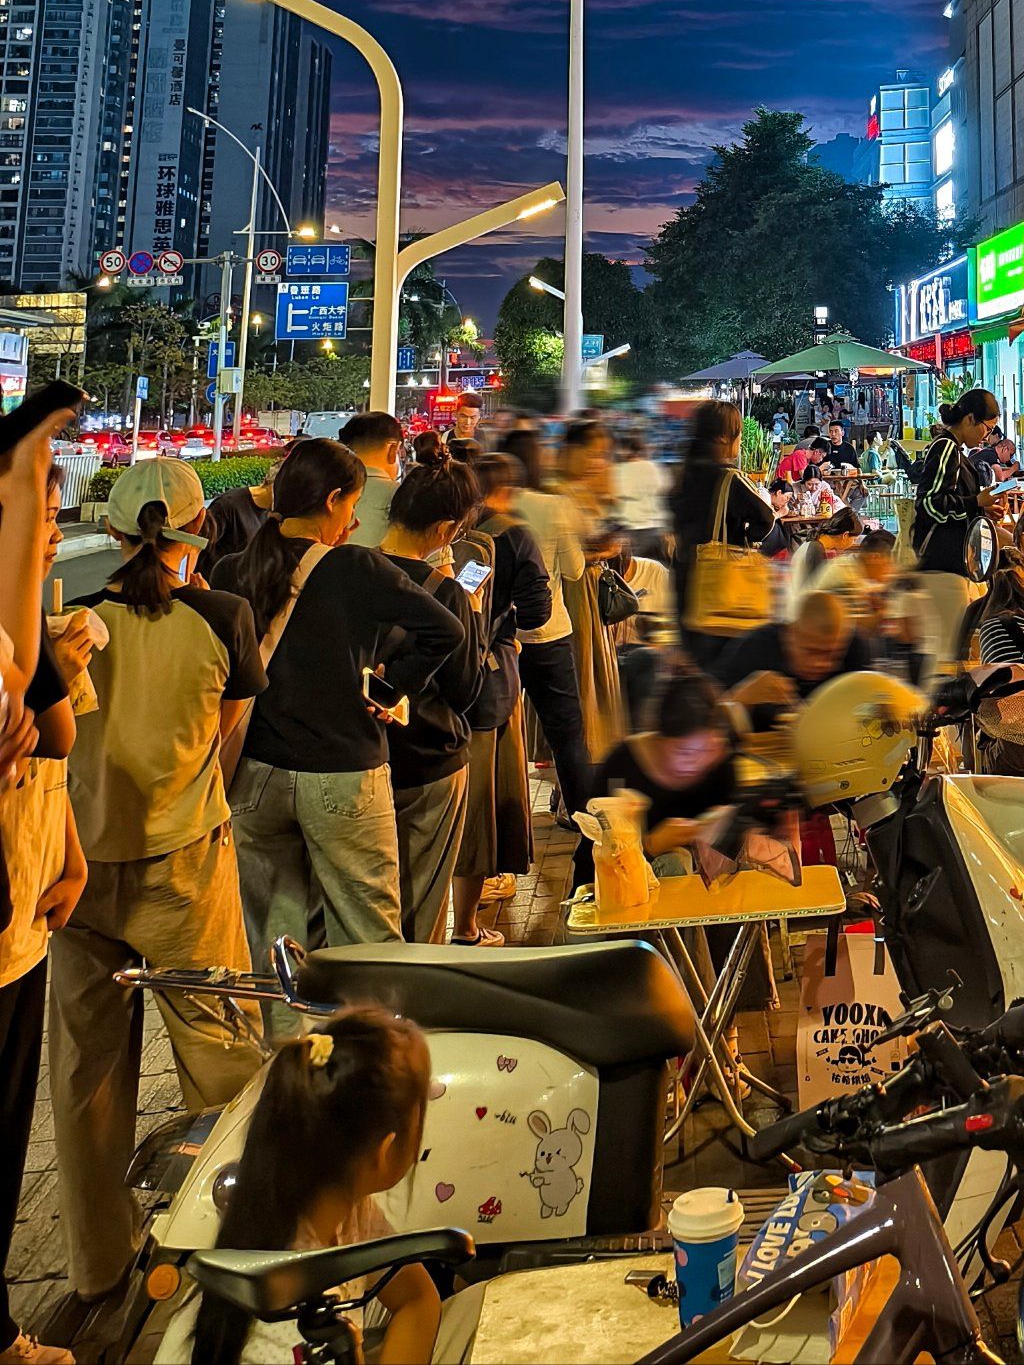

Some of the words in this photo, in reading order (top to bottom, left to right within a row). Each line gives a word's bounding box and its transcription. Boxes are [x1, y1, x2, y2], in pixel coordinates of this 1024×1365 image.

[106, 256, 121, 268] 50
[261, 255, 277, 267] 30
[290, 285, 321, 295] 鲁班路
[309, 305, 346, 315] 广西大学
[311, 321, 343, 332] 火炬路
[756, 1221, 791, 1271] LOVE
